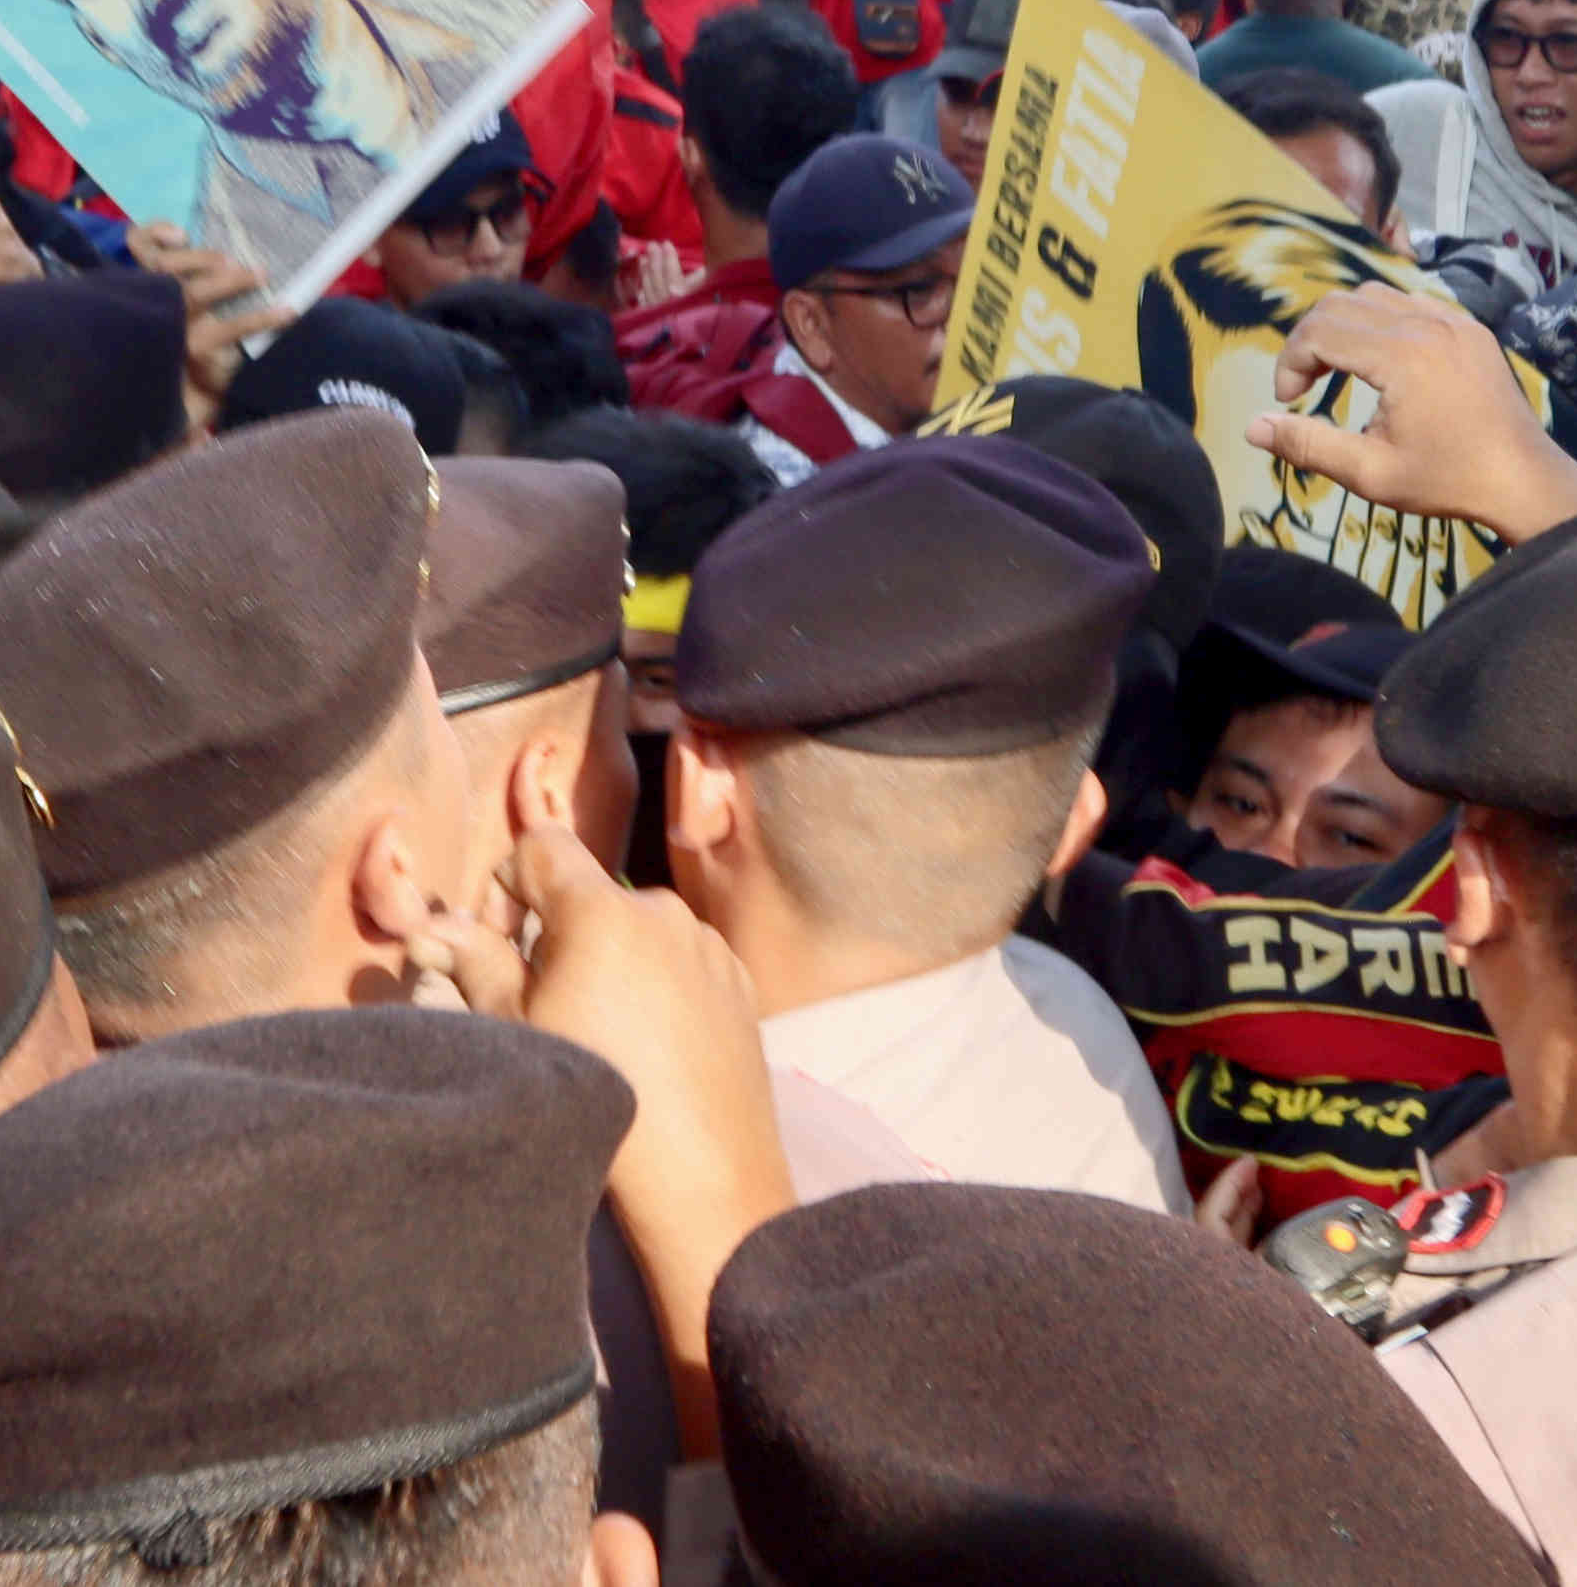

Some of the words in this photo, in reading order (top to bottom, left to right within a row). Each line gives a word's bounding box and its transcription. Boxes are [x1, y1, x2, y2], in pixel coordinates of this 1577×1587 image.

[986, 62, 1059, 276] BERSAMA
[1050, 27, 1147, 242] FATIA
[961, 261, 1014, 386] KAMI
[1037, 223, 1098, 302] &
